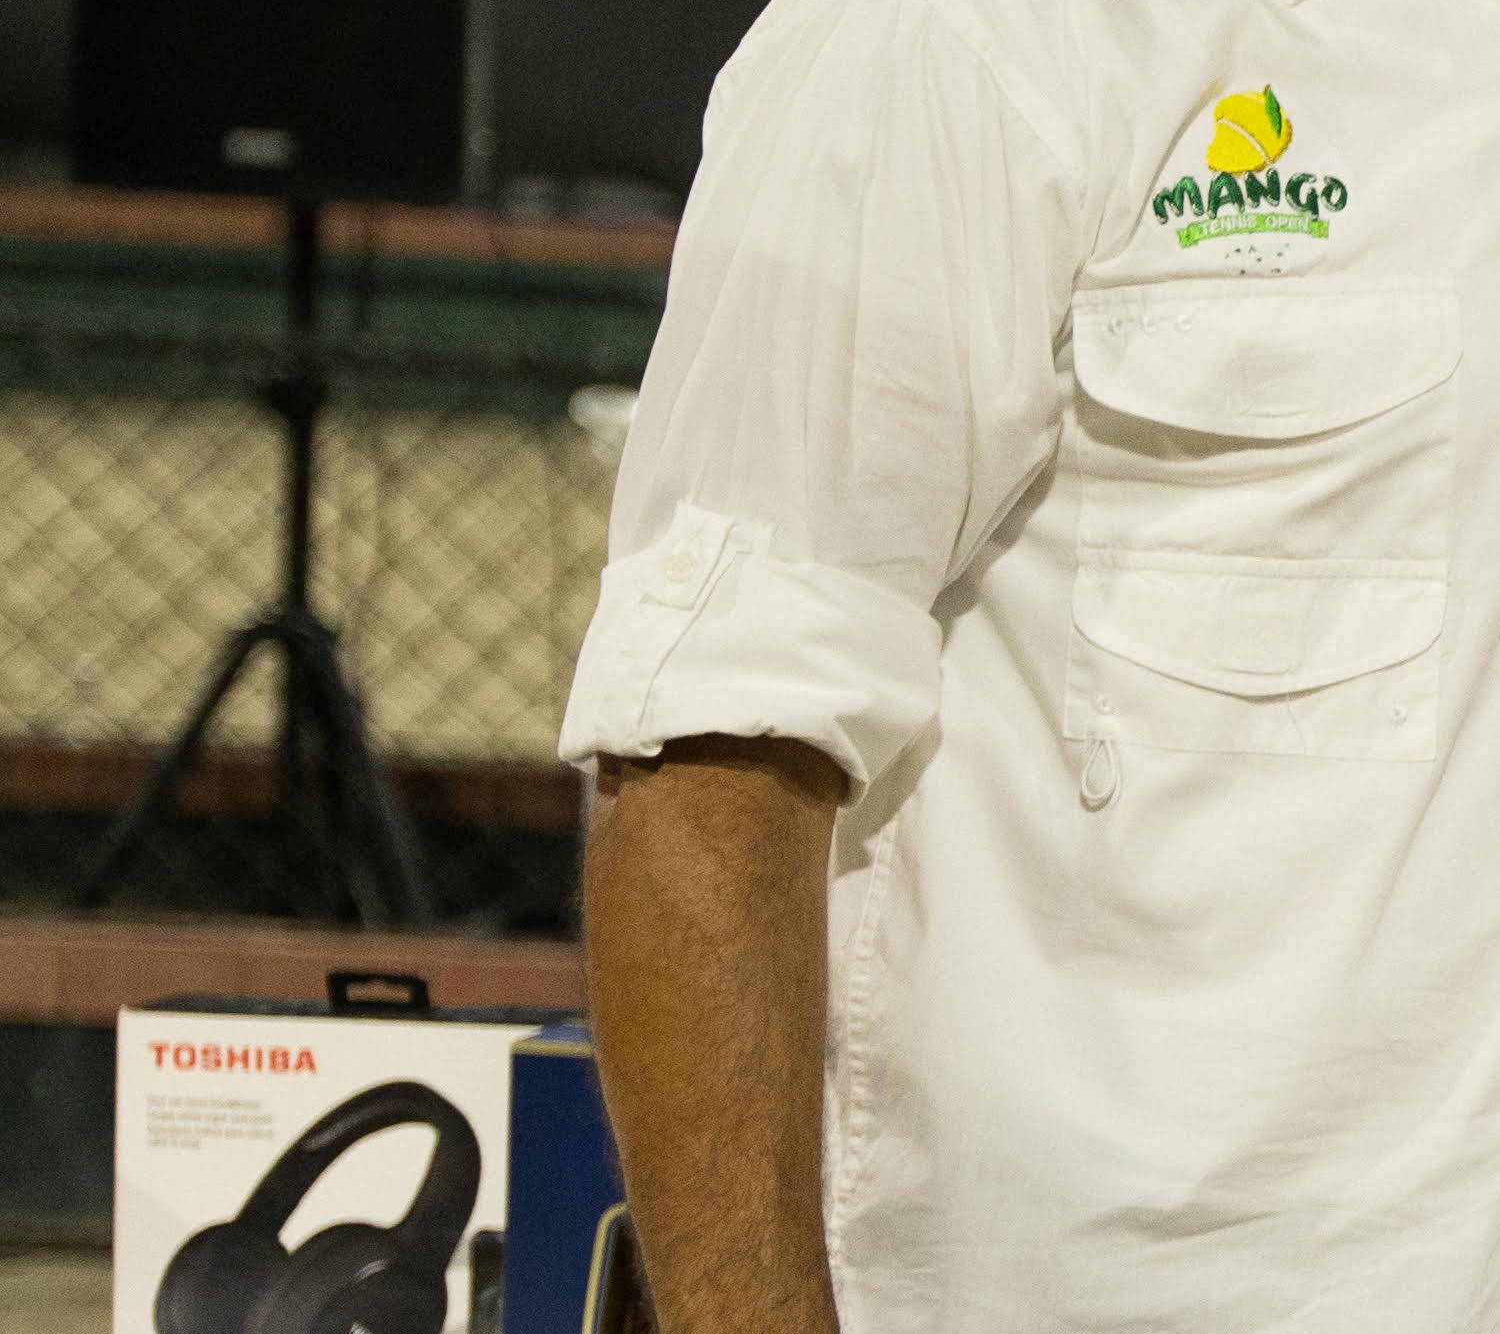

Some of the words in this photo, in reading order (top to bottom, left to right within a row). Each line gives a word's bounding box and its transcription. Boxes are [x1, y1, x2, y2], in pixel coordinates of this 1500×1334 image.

[1153, 167, 1348, 225] MANGO
[1201, 215, 1257, 235] TENNIS
[1265, 215, 1309, 231] OPEN
[148, 1041, 318, 1074] TOSHIBA
